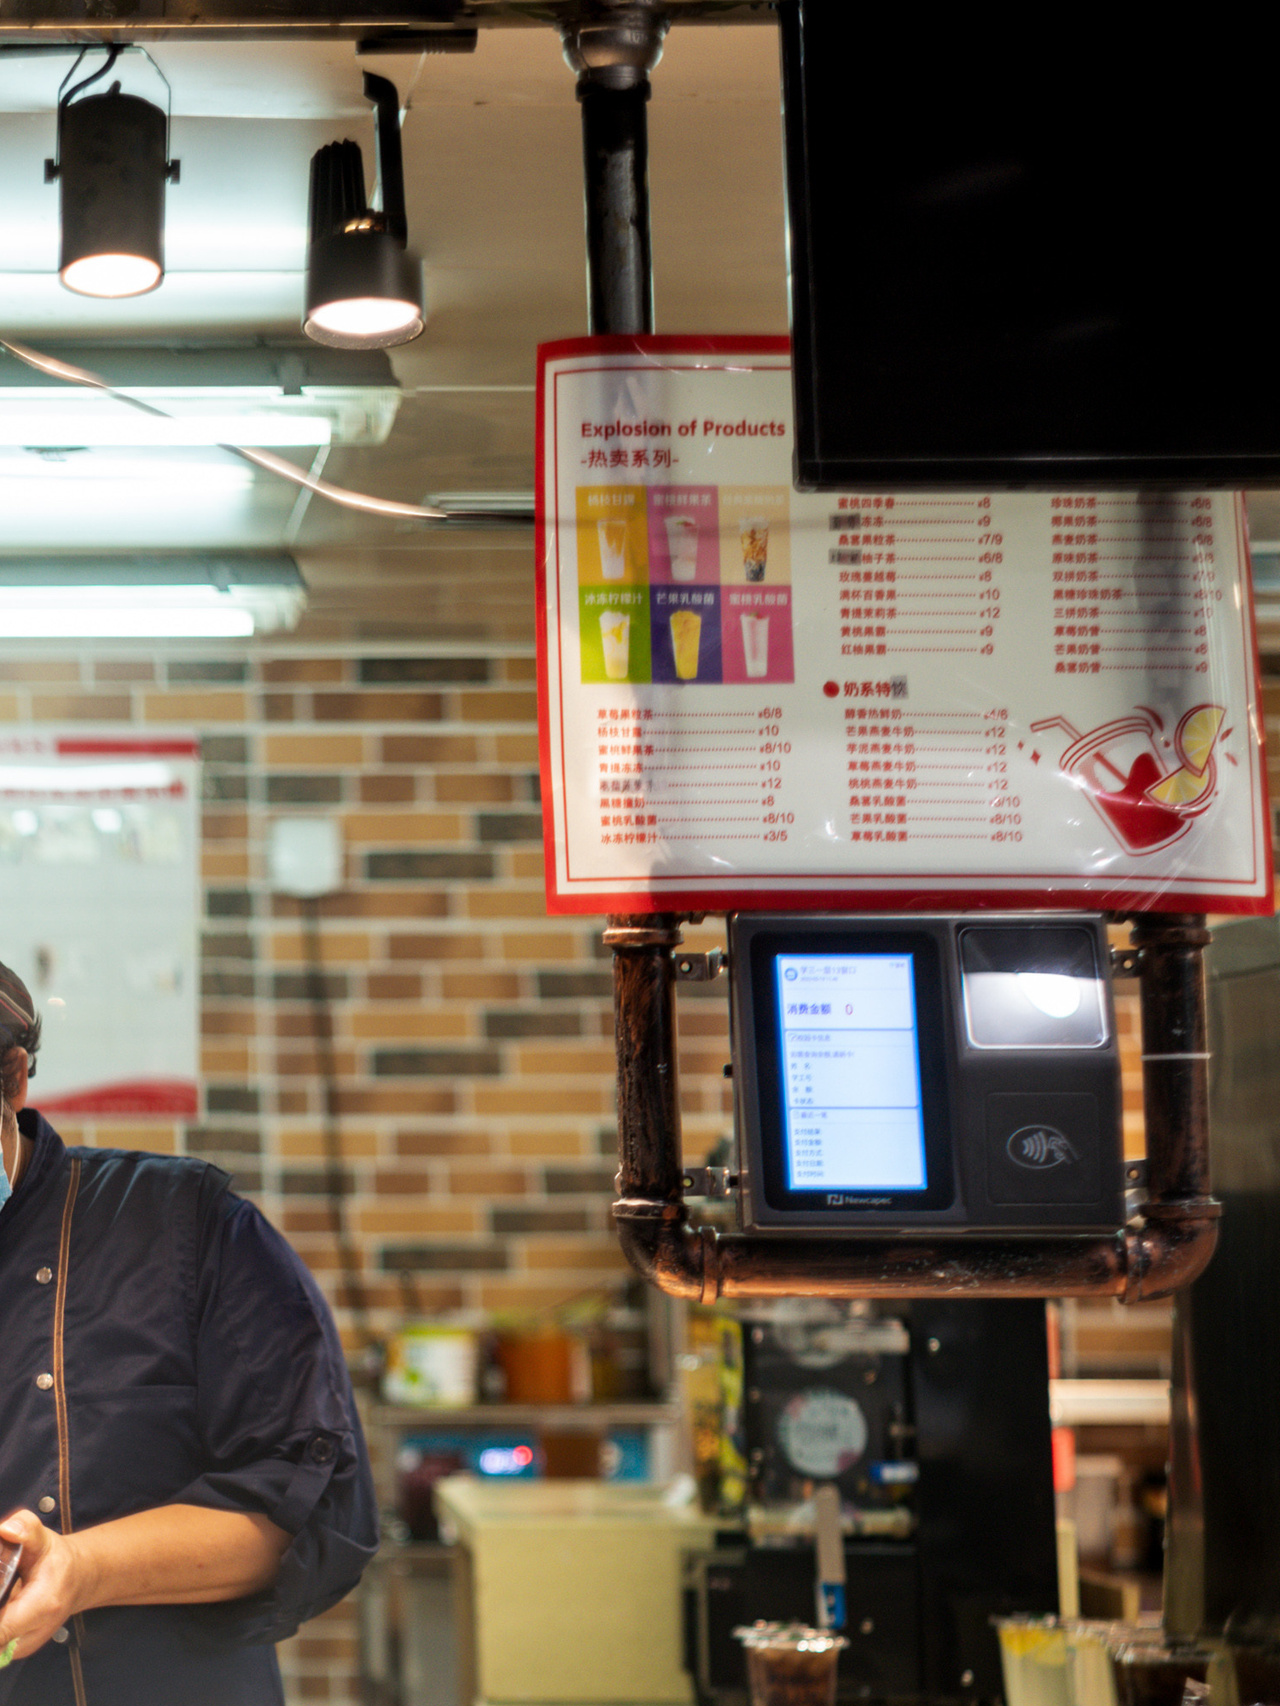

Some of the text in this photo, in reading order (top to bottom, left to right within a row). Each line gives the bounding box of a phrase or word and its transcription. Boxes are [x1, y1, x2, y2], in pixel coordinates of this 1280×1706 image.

[581, 419, 786, 440] Explosion of Products
